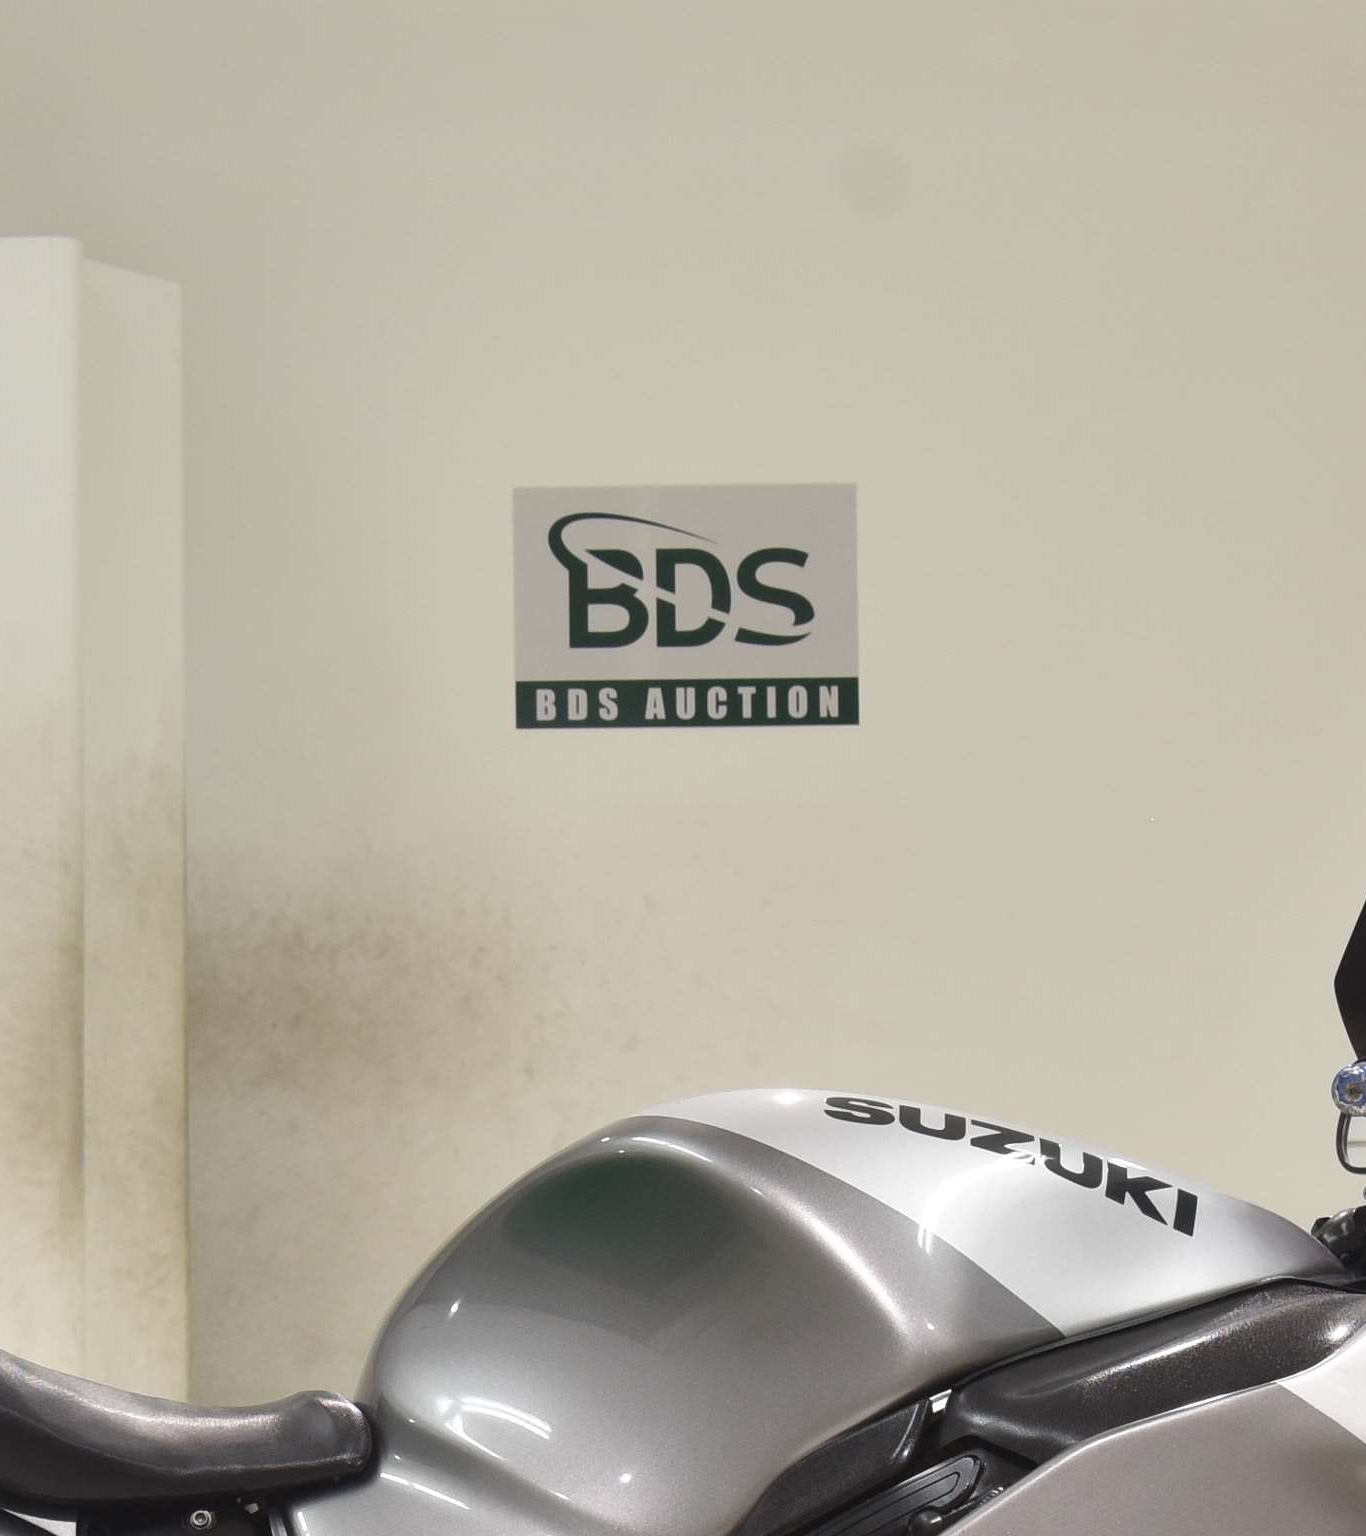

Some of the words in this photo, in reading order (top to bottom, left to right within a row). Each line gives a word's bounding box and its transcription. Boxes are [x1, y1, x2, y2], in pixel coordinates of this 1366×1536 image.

[548, 511, 816, 649] BDS
[536, 687, 619, 722] BDS
[645, 684, 840, 720] AUCTION
[823, 1096, 1199, 1238] SUZUKI
